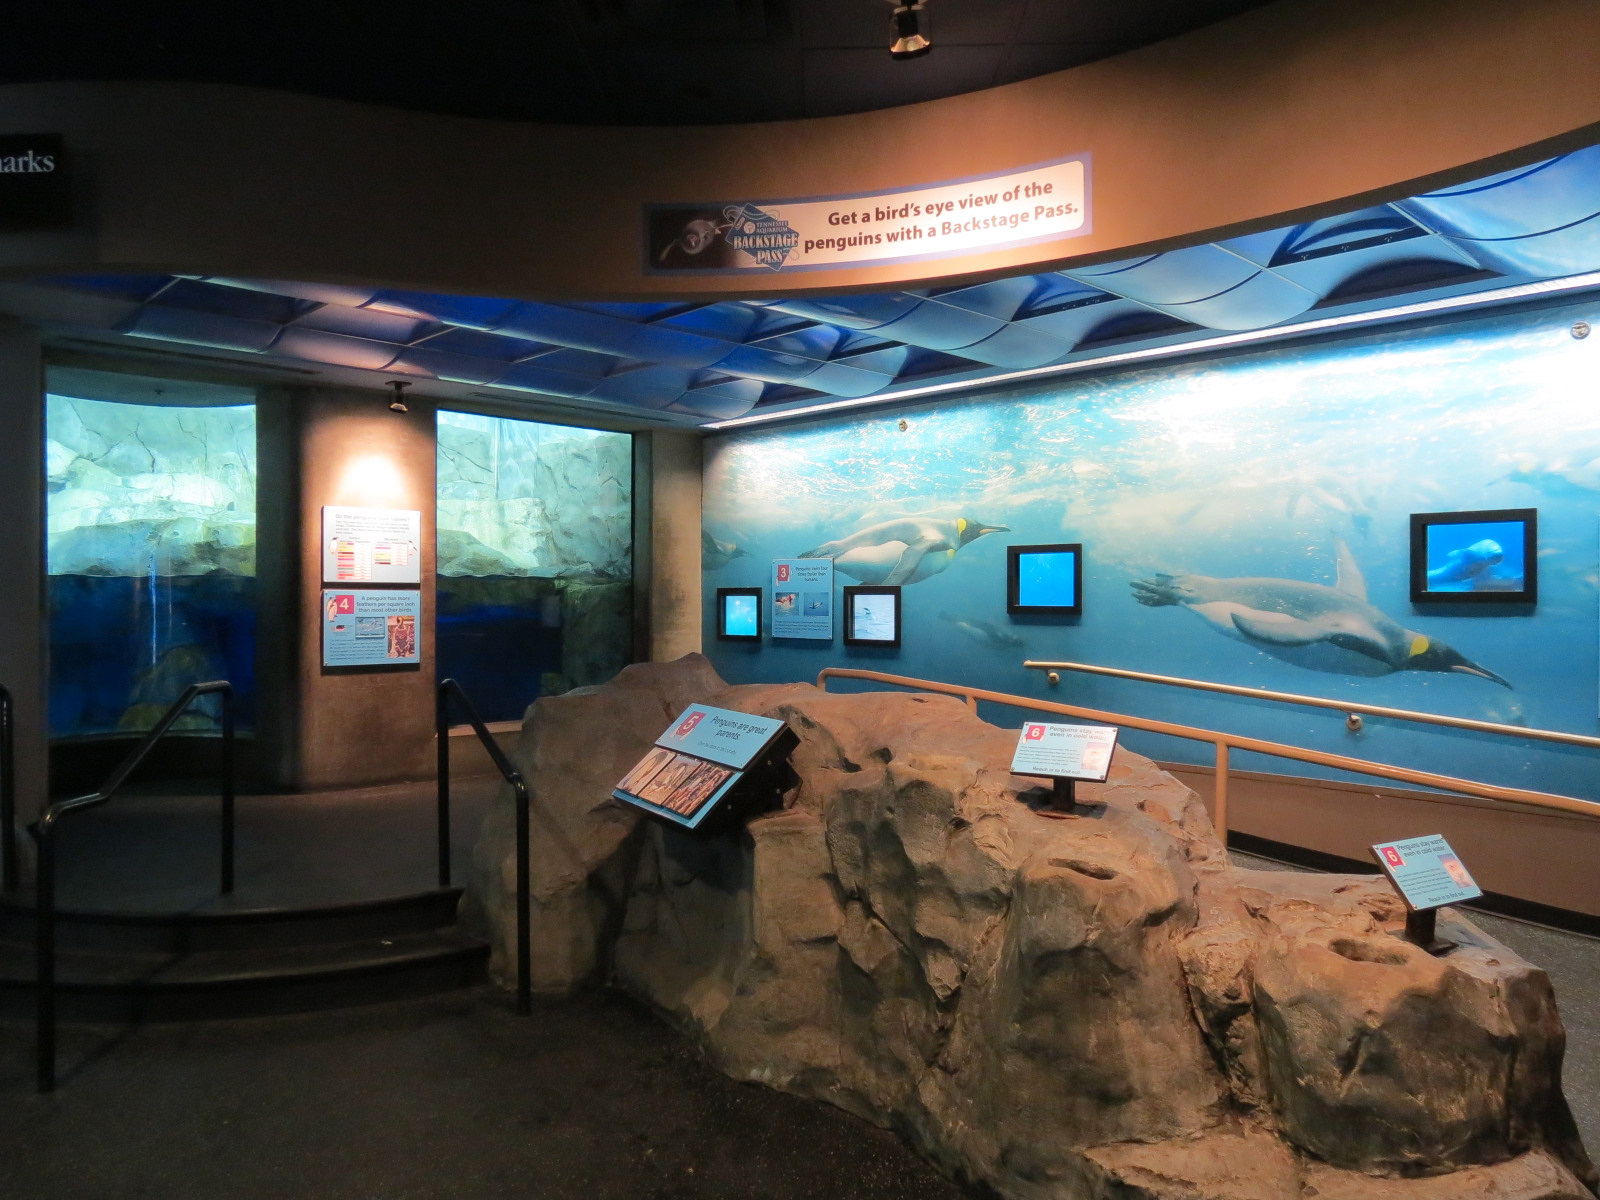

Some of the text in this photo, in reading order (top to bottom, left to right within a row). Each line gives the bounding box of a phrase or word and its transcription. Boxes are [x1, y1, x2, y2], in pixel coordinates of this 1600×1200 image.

[828, 182, 1053, 226] Get a bird's eye view of the
[804, 203, 1078, 253] penguins with a Backstage Pass.
[733, 233, 799, 250] BACKSTAGE
[756, 250, 783, 264] PASS
[781, 568, 786, 578] 3
[339, 598, 350, 610] 4
[683, 716, 699, 730] 5
[710, 716, 768, 735] Penguins are great
[1032, 728, 1040, 737] 6
[1396, 843, 1419, 851] Penguins
[1387, 851, 1398, 862] 6
